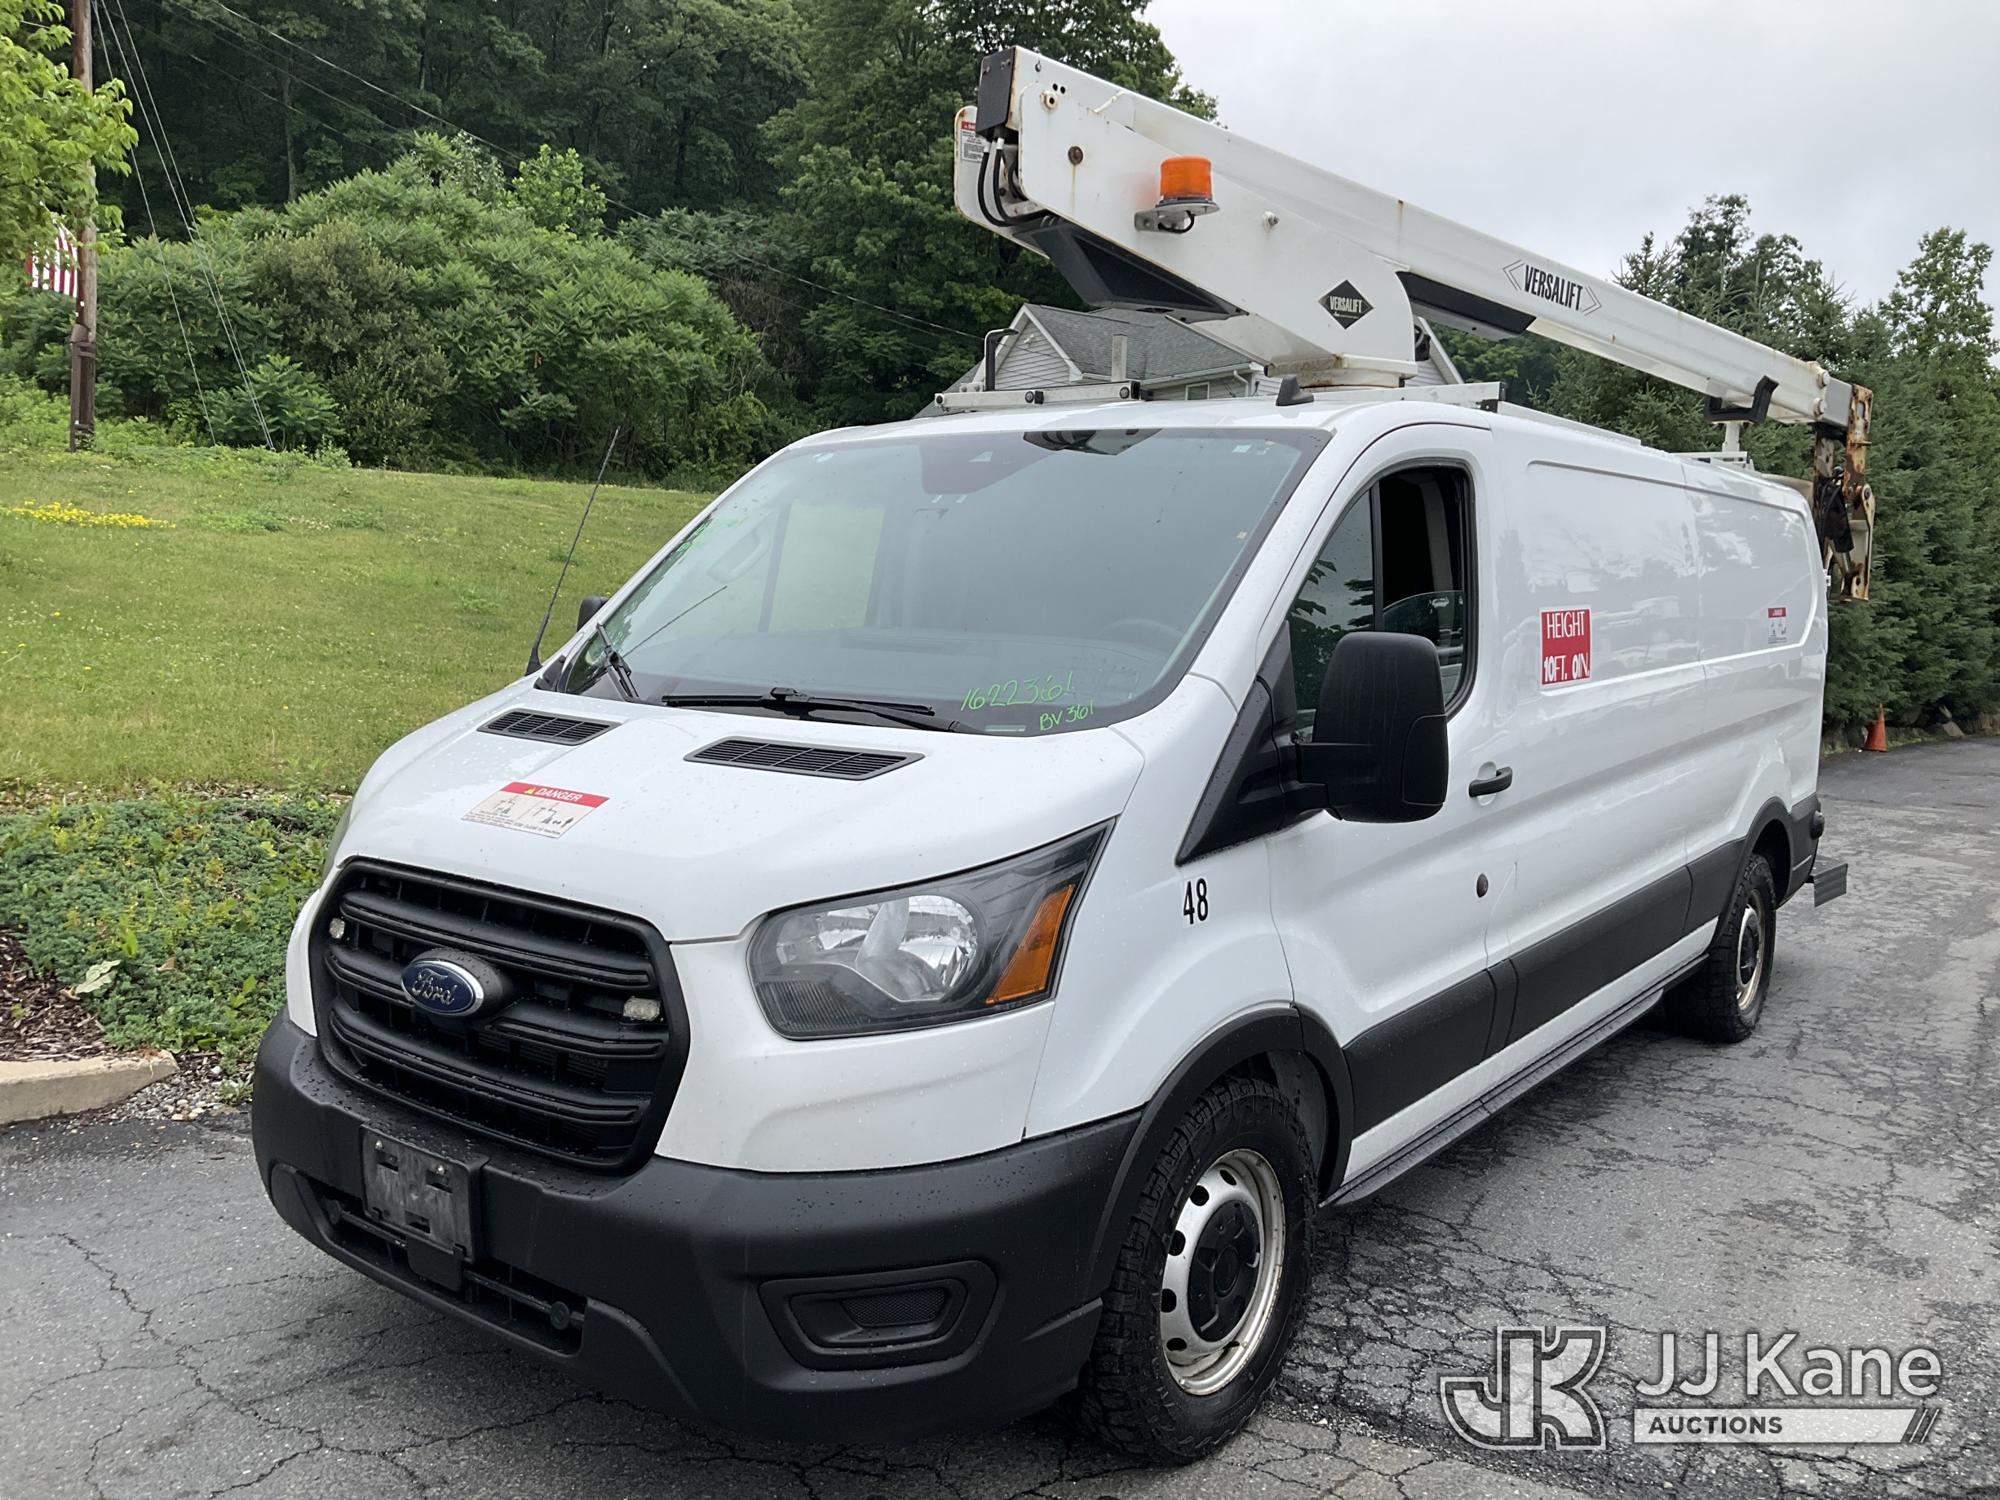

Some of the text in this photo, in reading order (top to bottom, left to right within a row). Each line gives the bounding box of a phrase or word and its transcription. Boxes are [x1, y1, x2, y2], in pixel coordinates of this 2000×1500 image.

[1329, 295, 1363, 314] VERSALIFT
[1524, 264, 1584, 311] VERSALIFT
[1546, 611, 1585, 639] HEIGHT
[960, 671, 1073, 711] 1622361
[534, 787, 584, 803] DANGER
[1183, 877, 1208, 925] 48
[411, 967, 458, 1006] Ford
